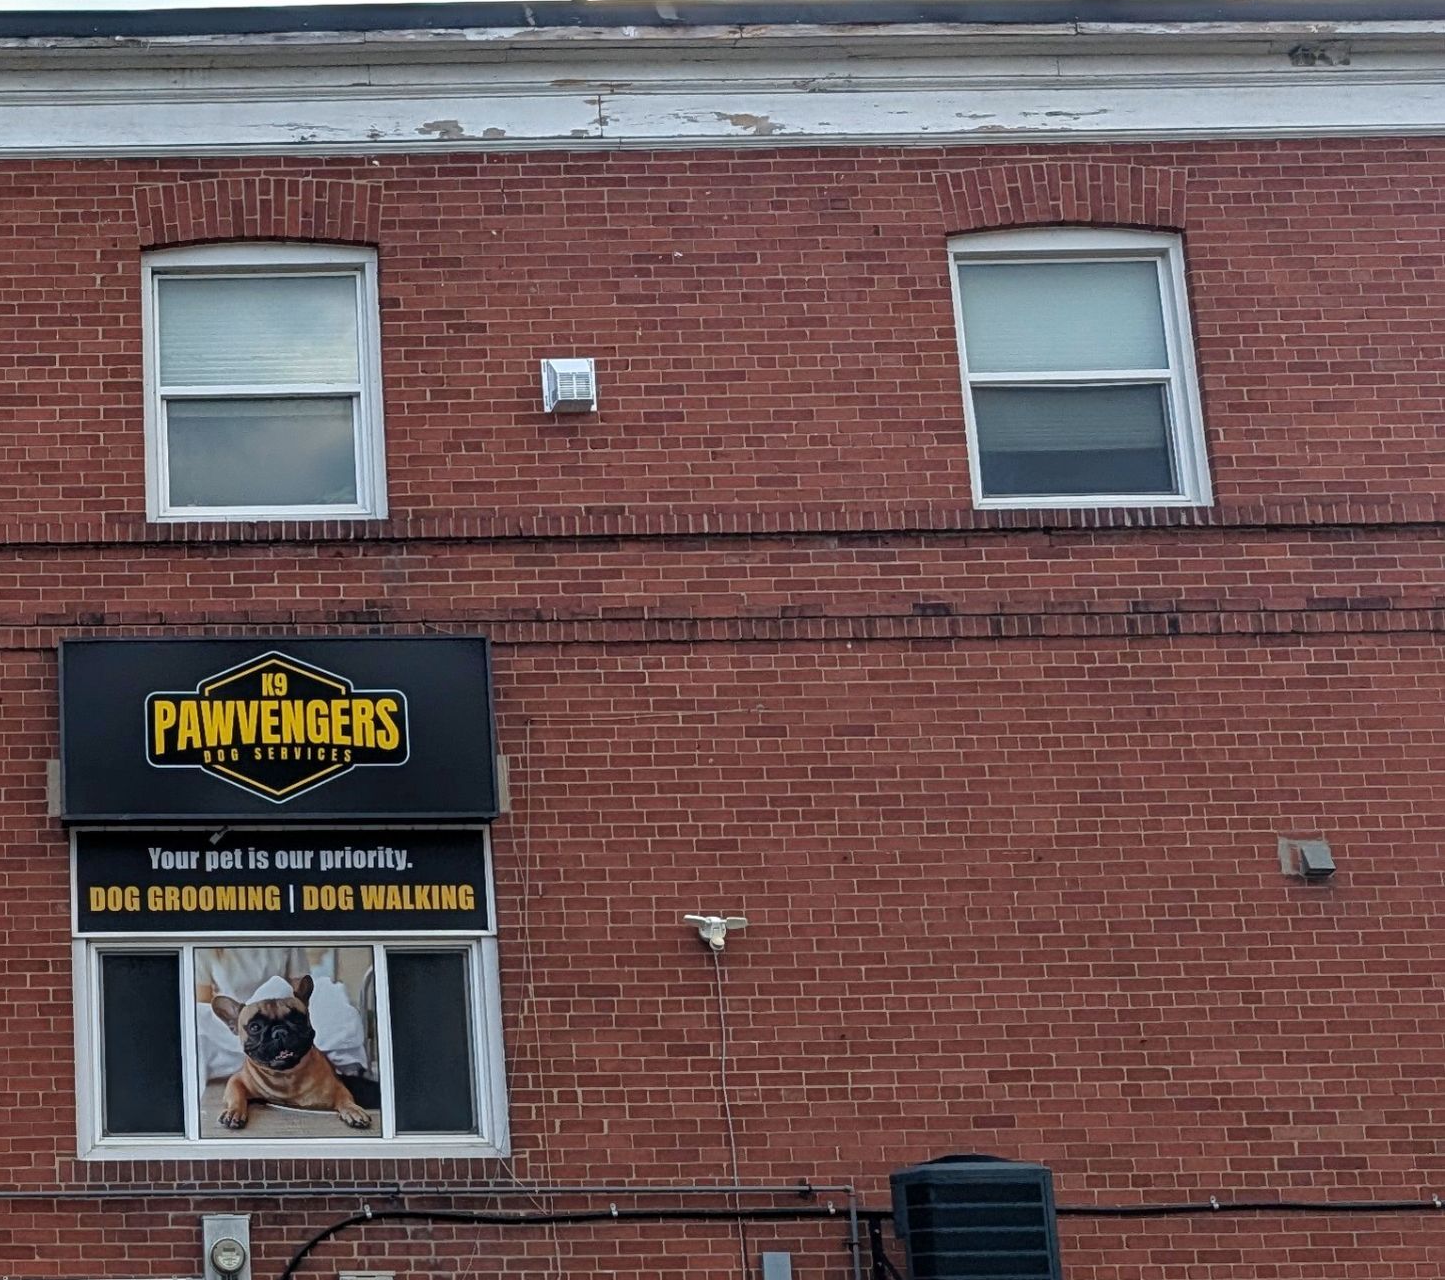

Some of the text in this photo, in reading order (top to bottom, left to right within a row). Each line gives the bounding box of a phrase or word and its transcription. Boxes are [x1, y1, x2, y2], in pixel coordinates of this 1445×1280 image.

[262, 673, 288, 696] K9
[154, 698, 400, 755] PAWVENGERS
[204, 747, 352, 763] DOG SERVICES
[148, 846, 413, 871] Your pet is our priority.
[90, 885, 140, 912] DOG
[147, 885, 281, 911] GROOMING
[303, 885, 354, 911] DOG
[360, 884, 475, 911] WALKING
